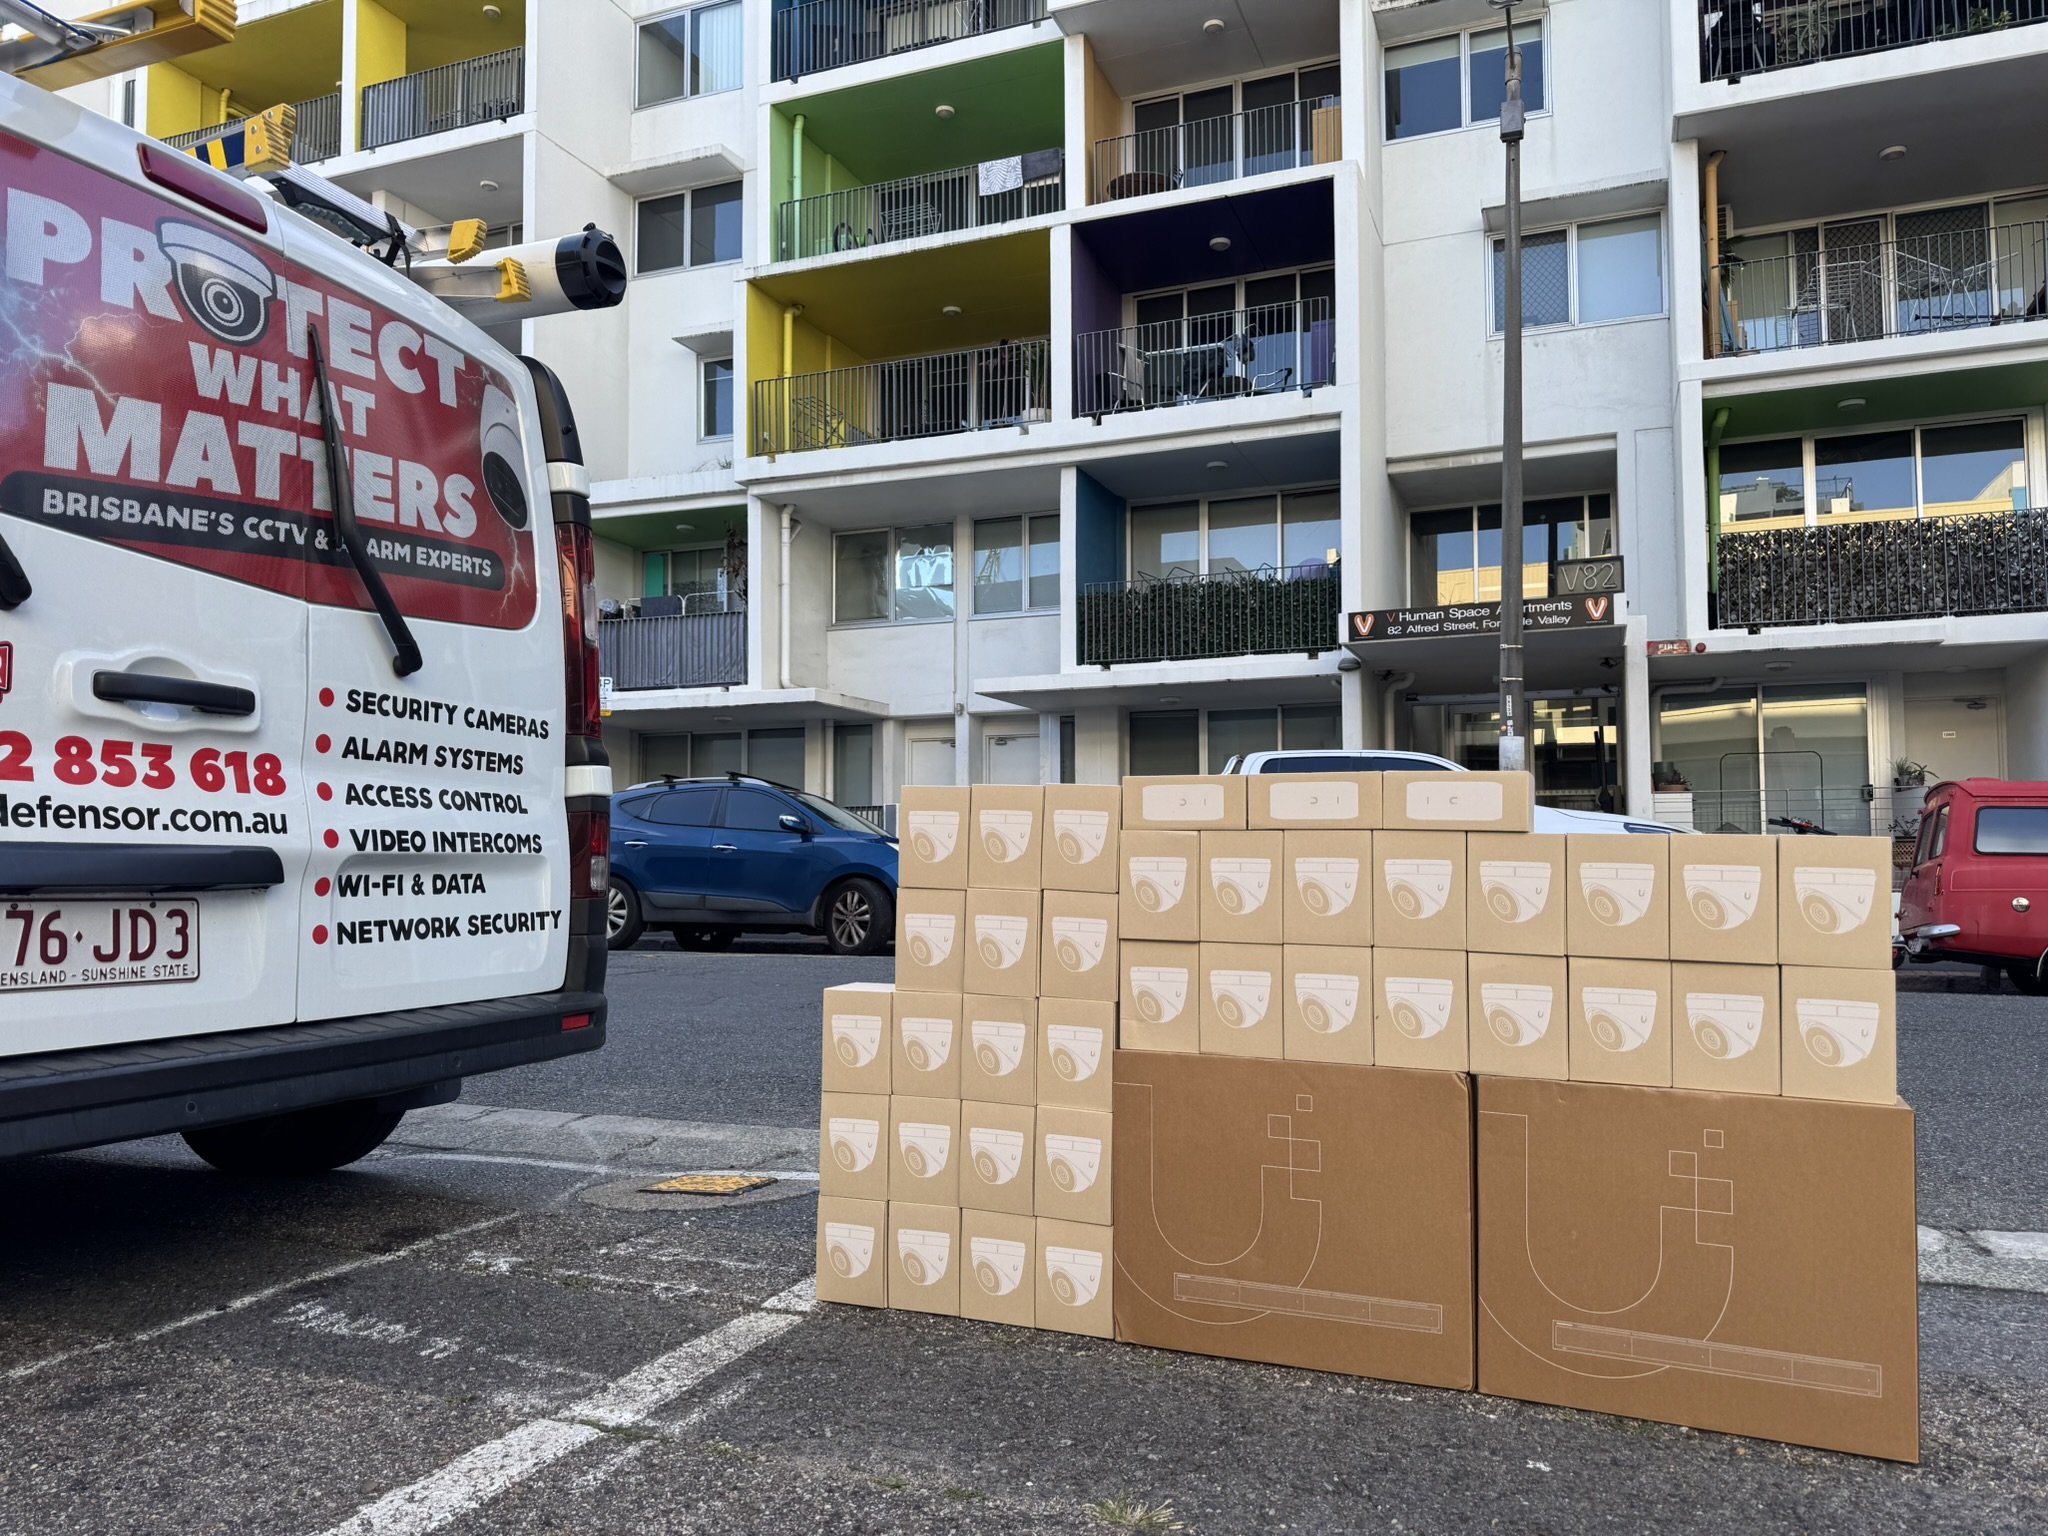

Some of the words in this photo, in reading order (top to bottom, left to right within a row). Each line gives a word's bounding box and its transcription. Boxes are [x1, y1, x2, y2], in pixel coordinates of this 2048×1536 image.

[188, 341, 376, 438] WHAT
[43, 382, 477, 539] MATTERS
[43, 489, 235, 535] BRISBANE'S
[243, 516, 308, 546] CCTV
[314, 528, 329, 551] &
[336, 535, 411, 564] ARM
[416, 545, 493, 578] EXPERTS
[1561, 562, 1617, 591] V82
[1387, 626, 1402, 635] 82
[1406, 623, 1439, 634] Alfred
[1443, 620, 1480, 632] Street,
[1537, 614, 1572, 626] Valley
[1399, 610, 1445, 622] Human
[1449, 607, 1490, 620] Space
[1495, 600, 1573, 615] rtments
[345, 689, 458, 725] SECURITY
[463, 707, 549, 739] CAMERAS
[53, 735, 176, 789] 853
[189, 747, 287, 796] 618
[341, 736, 428, 766] ALARM
[433, 745, 524, 775] SYSTEMS
[345, 783, 433, 809] ACCESS
[438, 789, 529, 815] CONTROL
[349, 828, 426, 852] VIDEO
[432, 831, 543, 854] INTERCOMS
[337, 874, 403, 897] WI-FI
[411, 873, 425, 896] &
[432, 873, 486, 895] DATA
[337, 916, 461, 945] NETWORK
[467, 910, 562, 936] SECURITY
[81, 965, 147, 982] SUNSHINE
[153, 963, 189, 977] STATE
